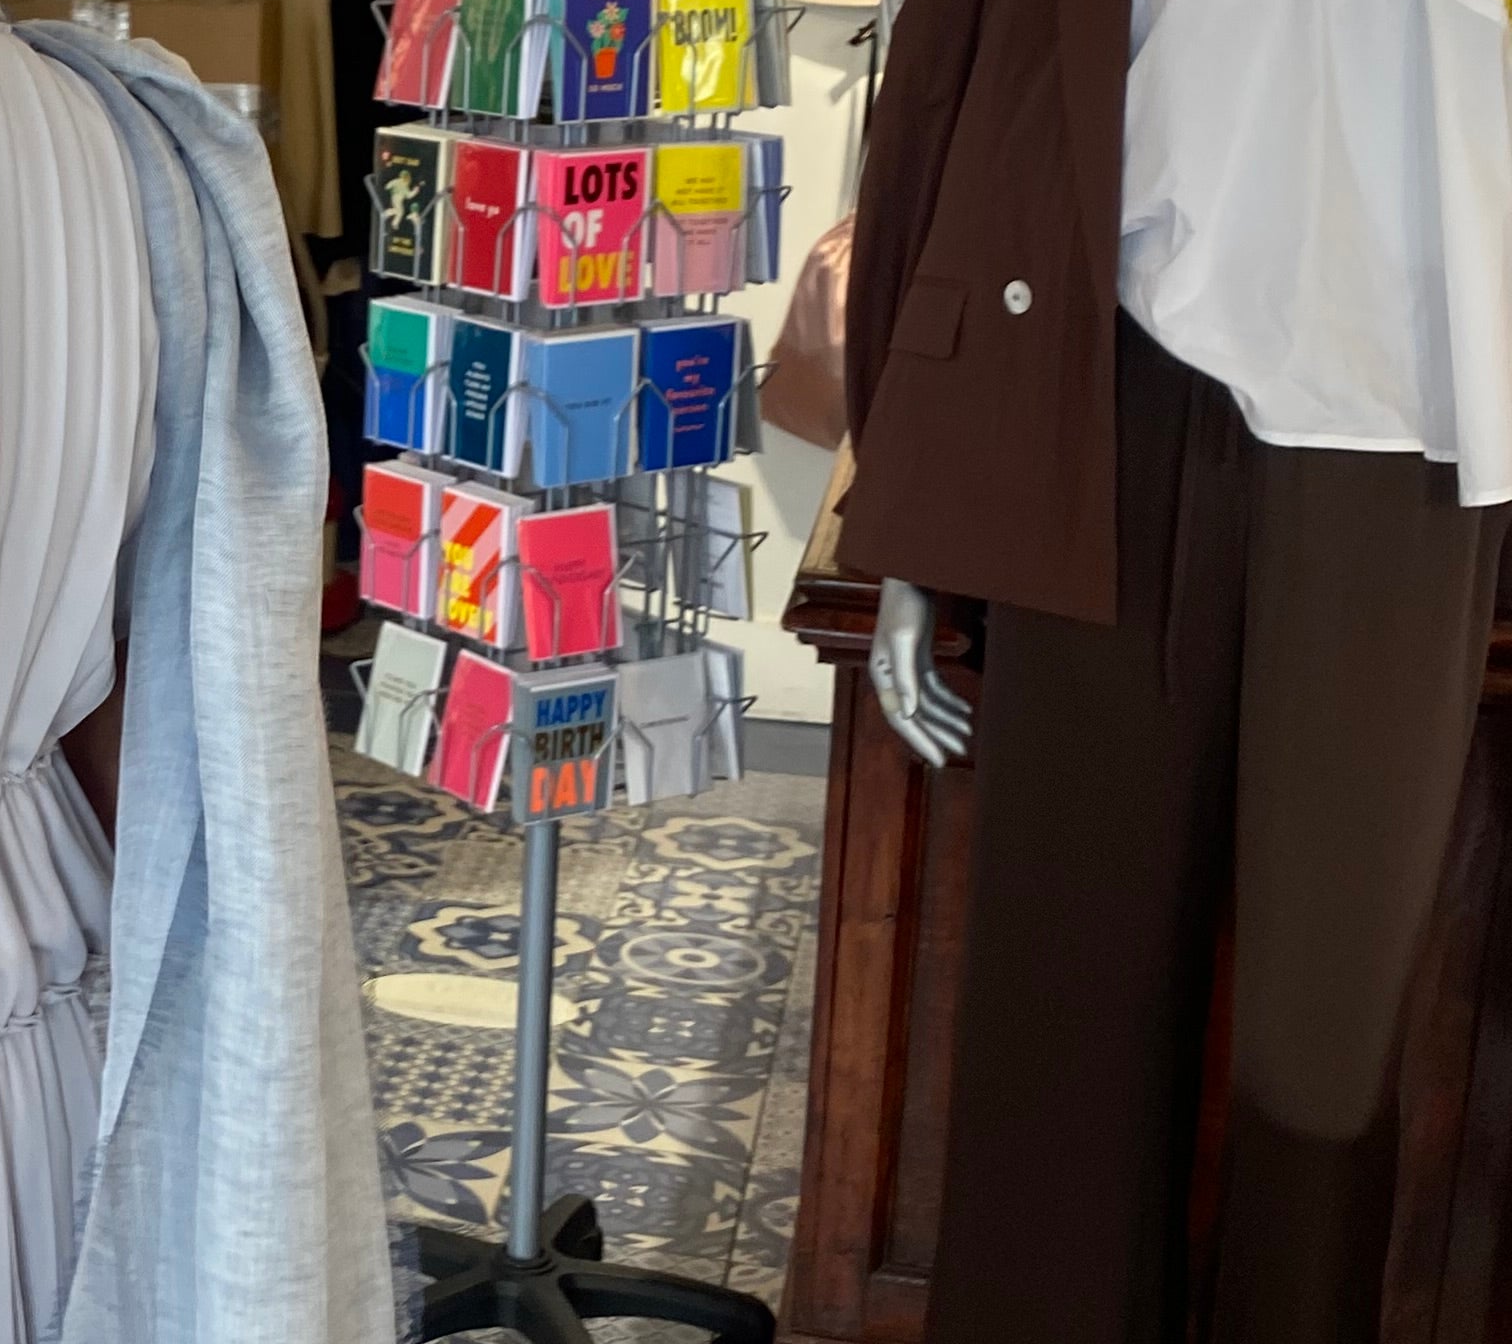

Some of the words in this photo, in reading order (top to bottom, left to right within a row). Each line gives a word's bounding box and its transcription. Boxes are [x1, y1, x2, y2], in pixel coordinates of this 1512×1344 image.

[564, 161, 638, 206] LOTS
[562, 208, 604, 249] OF
[558, 251, 635, 294] LOVE
[536, 689, 607, 728] HAPPY
[535, 722, 604, 762] BIRTH
[530, 760, 599, 813] DAY
